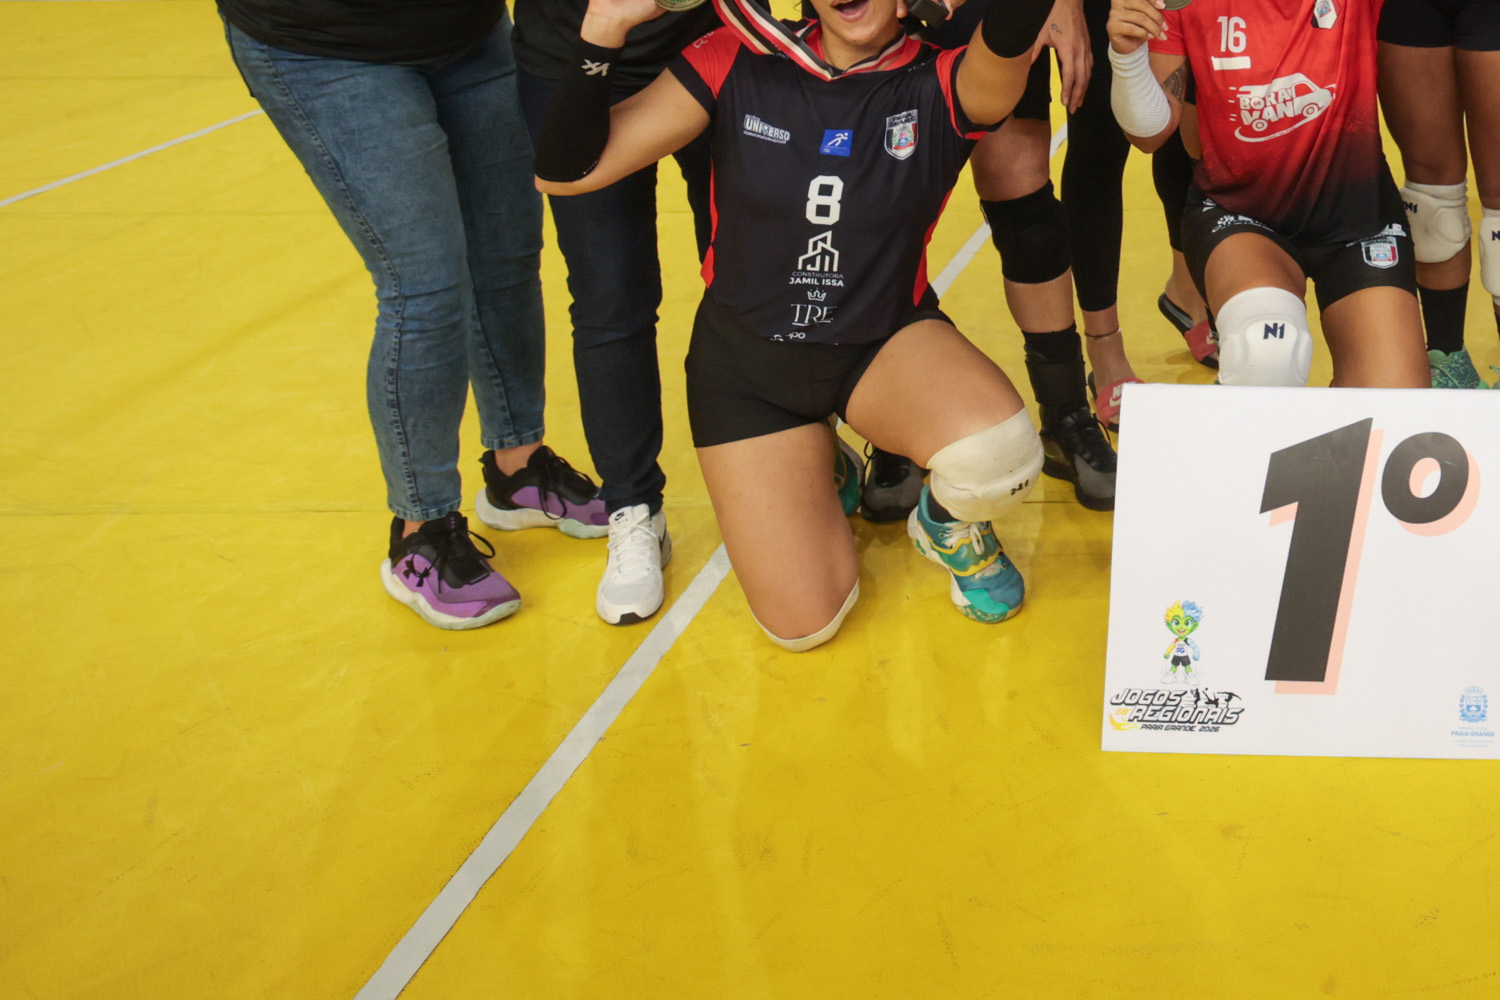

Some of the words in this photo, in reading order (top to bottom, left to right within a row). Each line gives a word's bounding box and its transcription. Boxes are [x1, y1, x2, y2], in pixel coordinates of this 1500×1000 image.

[1217, 16, 1247, 53] 16
[805, 175, 844, 225] 8
[788, 277, 820, 285] JAMIL
[822, 279, 844, 287] ISSA
[791, 271, 844, 279] CONSTRUTORA
[1263, 322, 1285, 339] N1
[1110, 687, 1188, 706] JOGOS
[1128, 705, 1245, 726] REGIONAIS
